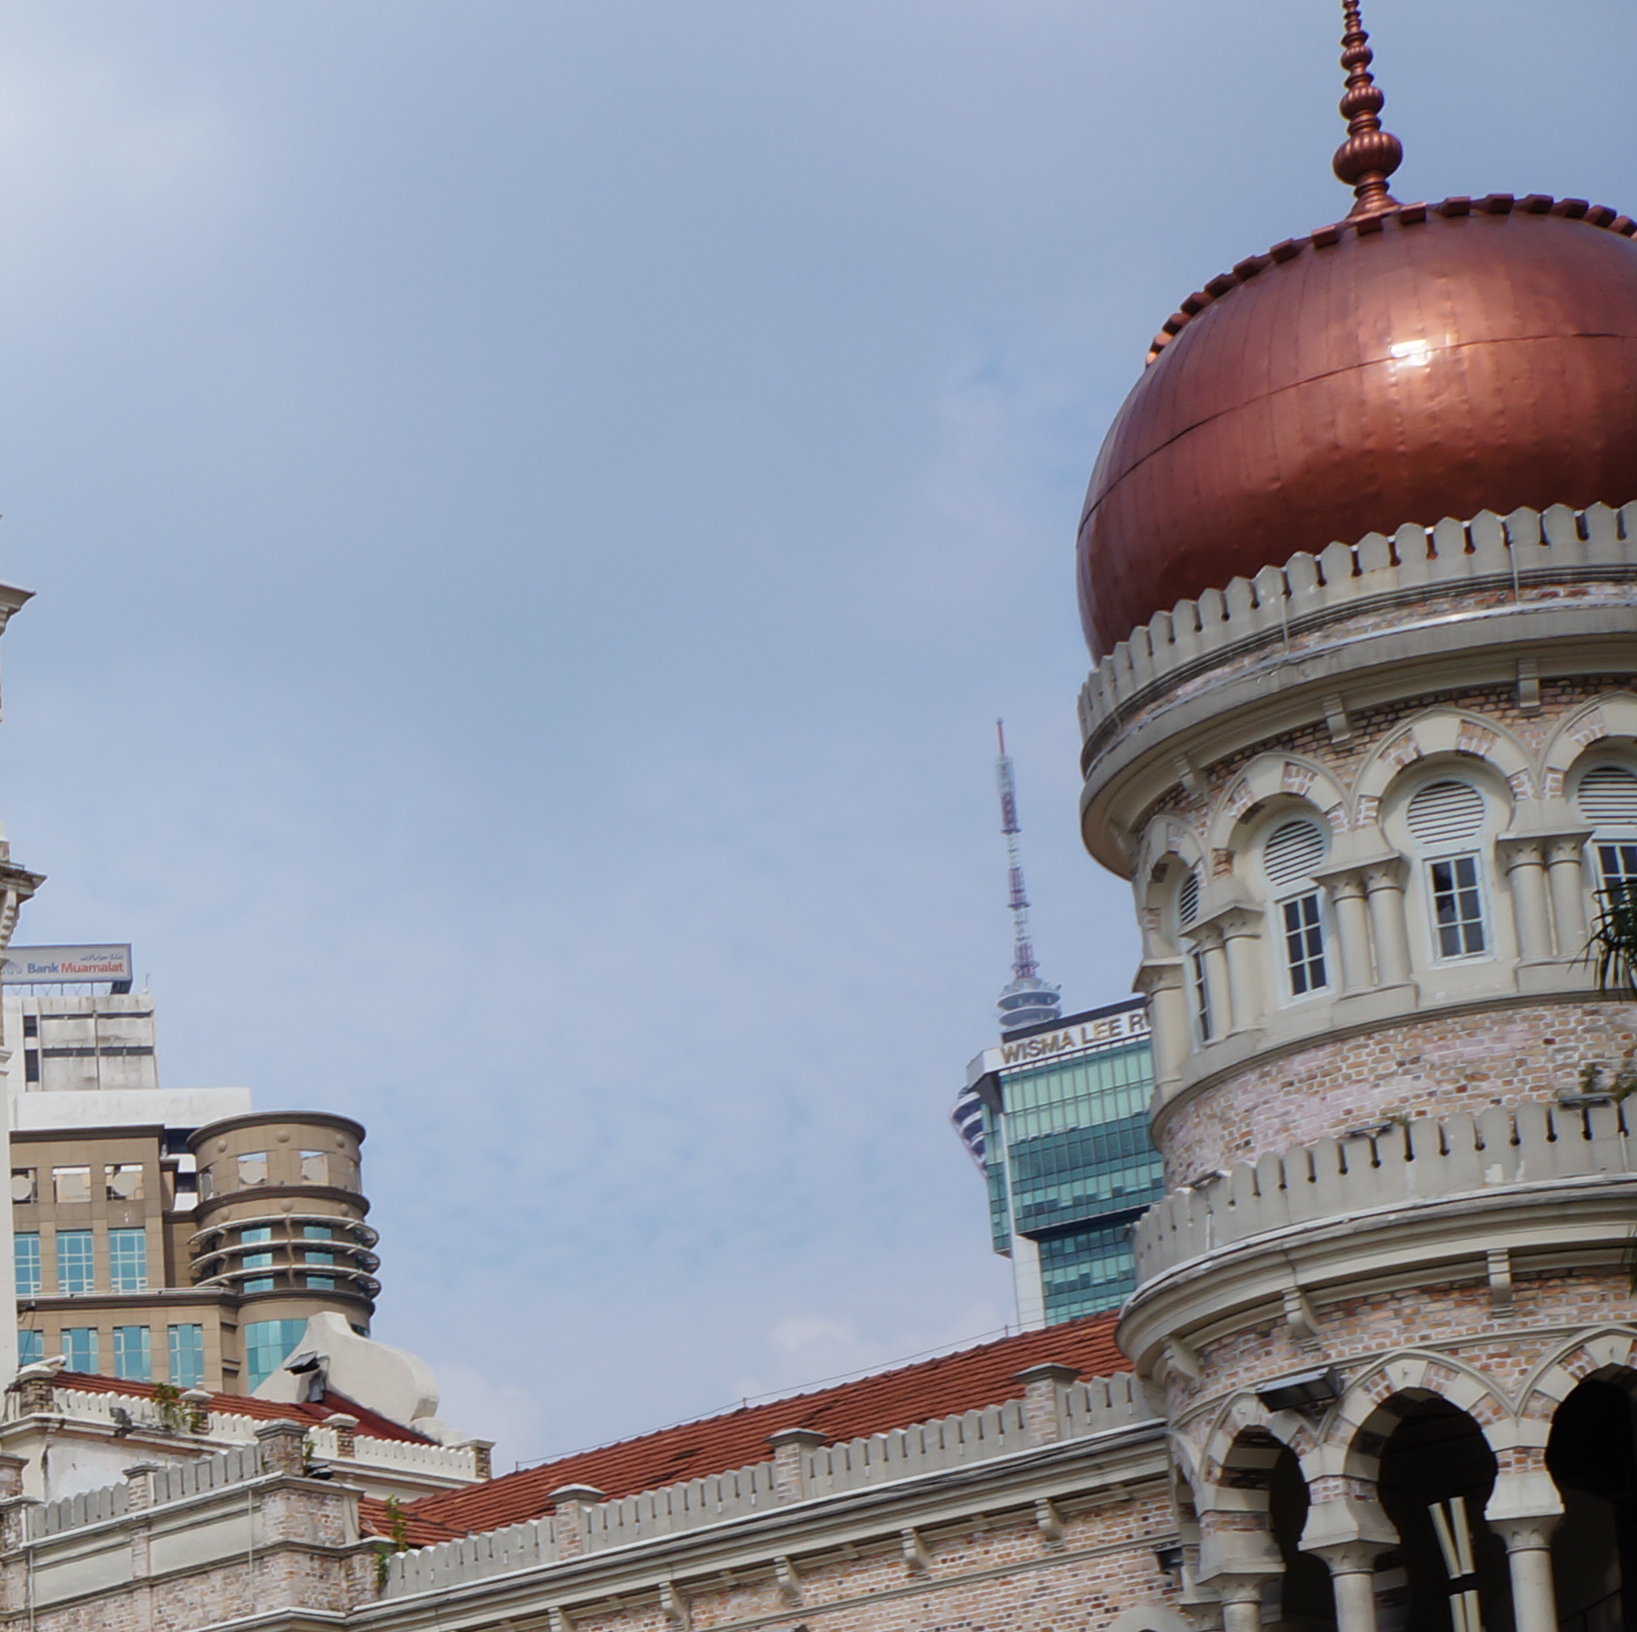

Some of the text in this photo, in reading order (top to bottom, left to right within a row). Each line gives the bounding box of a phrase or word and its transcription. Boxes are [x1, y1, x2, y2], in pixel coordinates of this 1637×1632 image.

[27, 961, 125, 974] Bank Muamalat
[1000, 1031, 1075, 1065] WISMA
[1081, 1018, 1122, 1044] LEE
